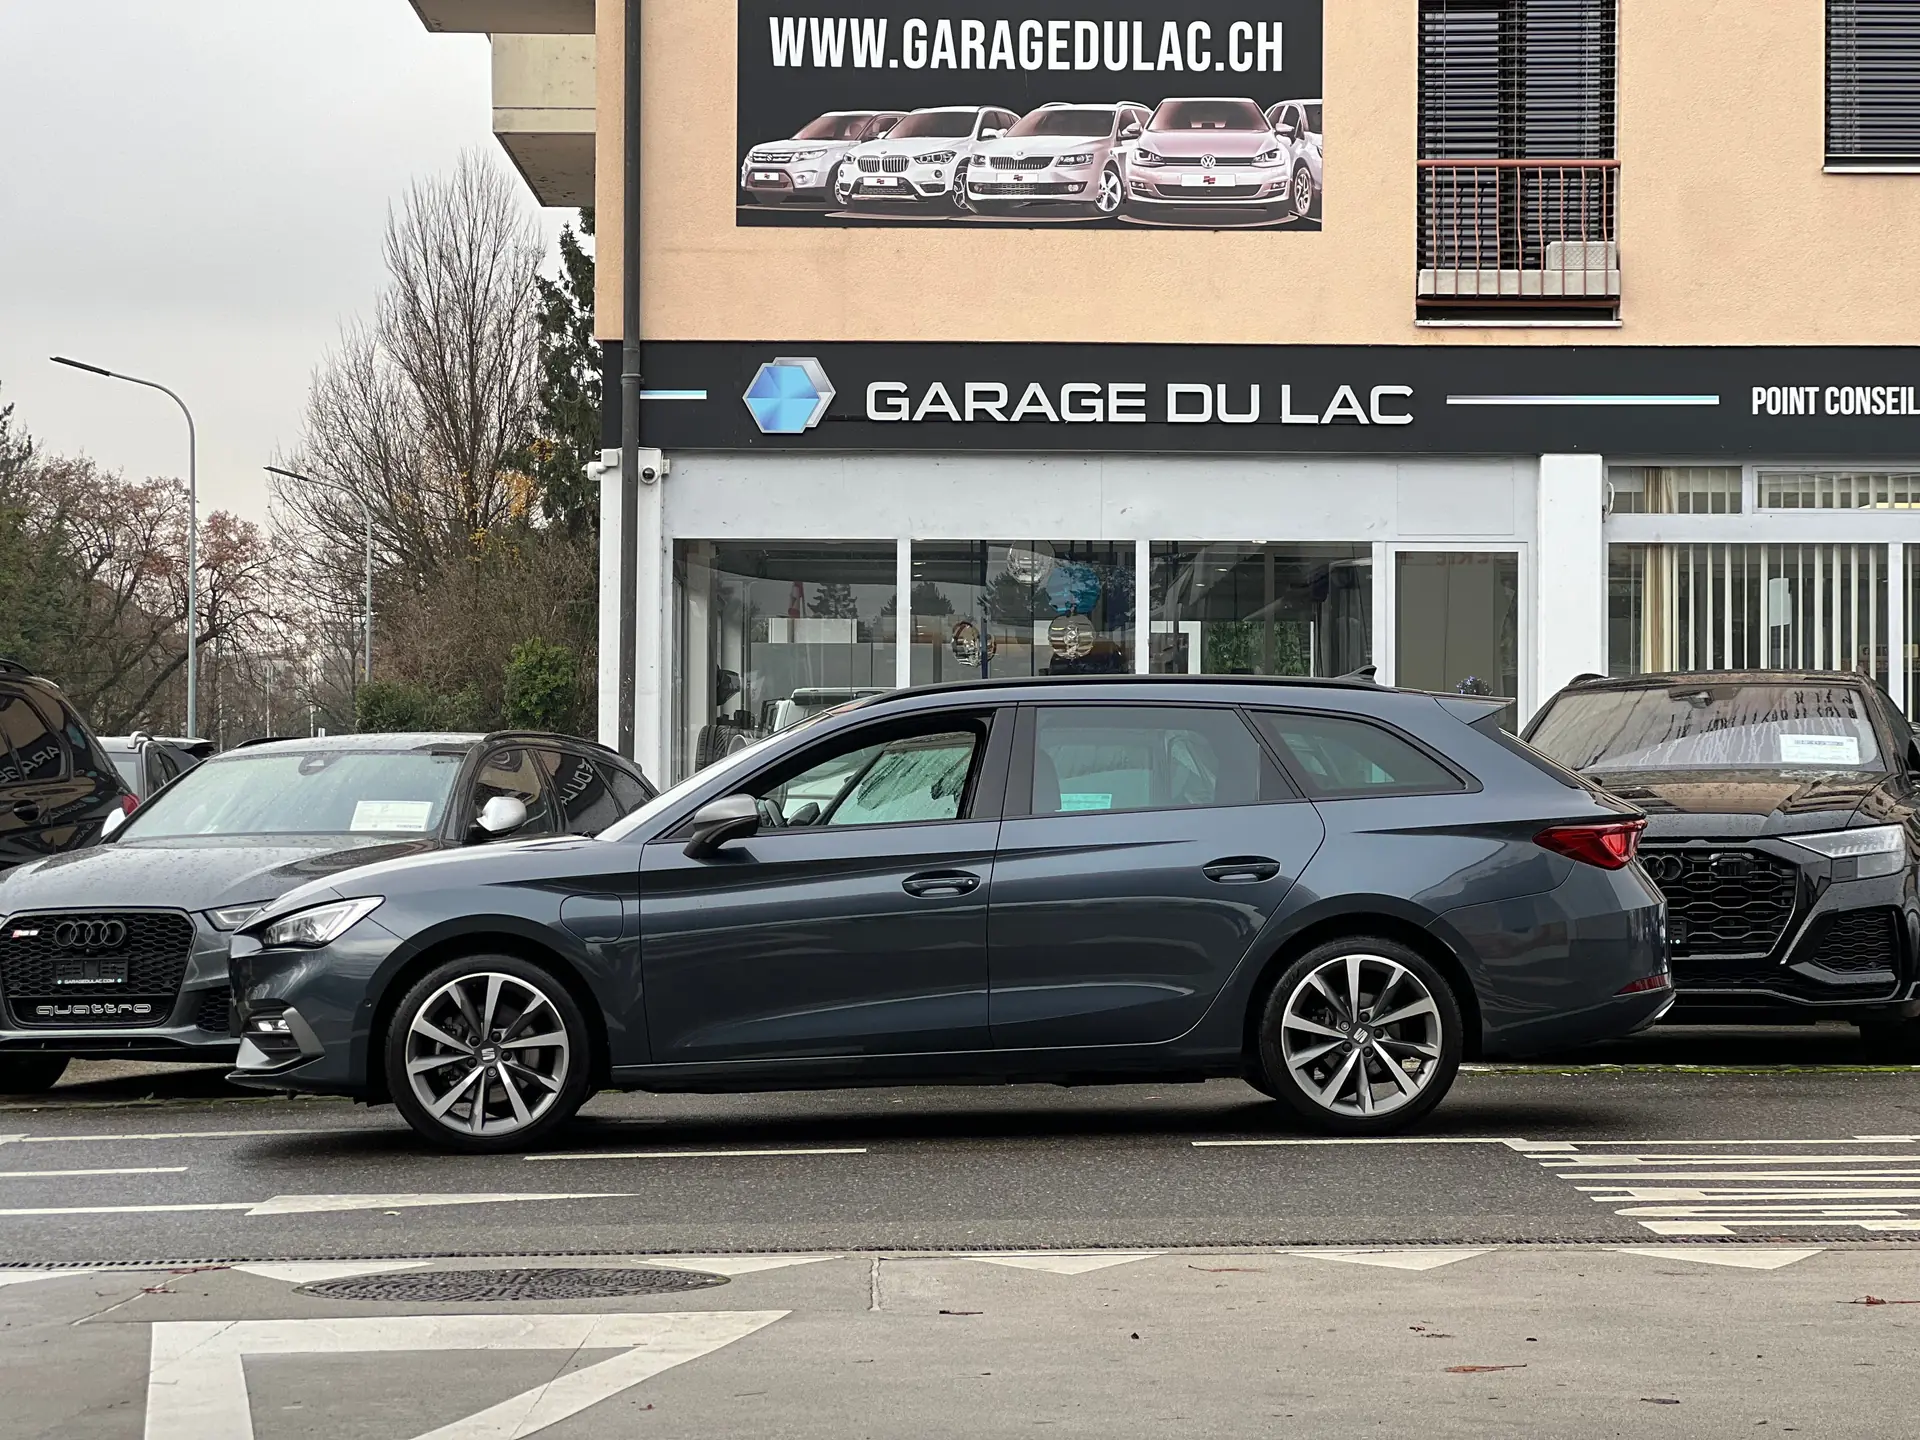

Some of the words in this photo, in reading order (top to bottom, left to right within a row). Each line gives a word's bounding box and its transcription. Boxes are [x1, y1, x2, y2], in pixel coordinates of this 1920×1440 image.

[769, 16, 1283, 72] WWW.GARAGEDULAC.CH
[866, 381, 1146, 424] GARAGE
[1167, 383, 1260, 423] DU
[1281, 384, 1414, 425] LAC
[1752, 386, 1820, 415] POINT
[1824, 386, 1920, 415] CONSEIL
[36, 1003, 151, 1016] quattro
